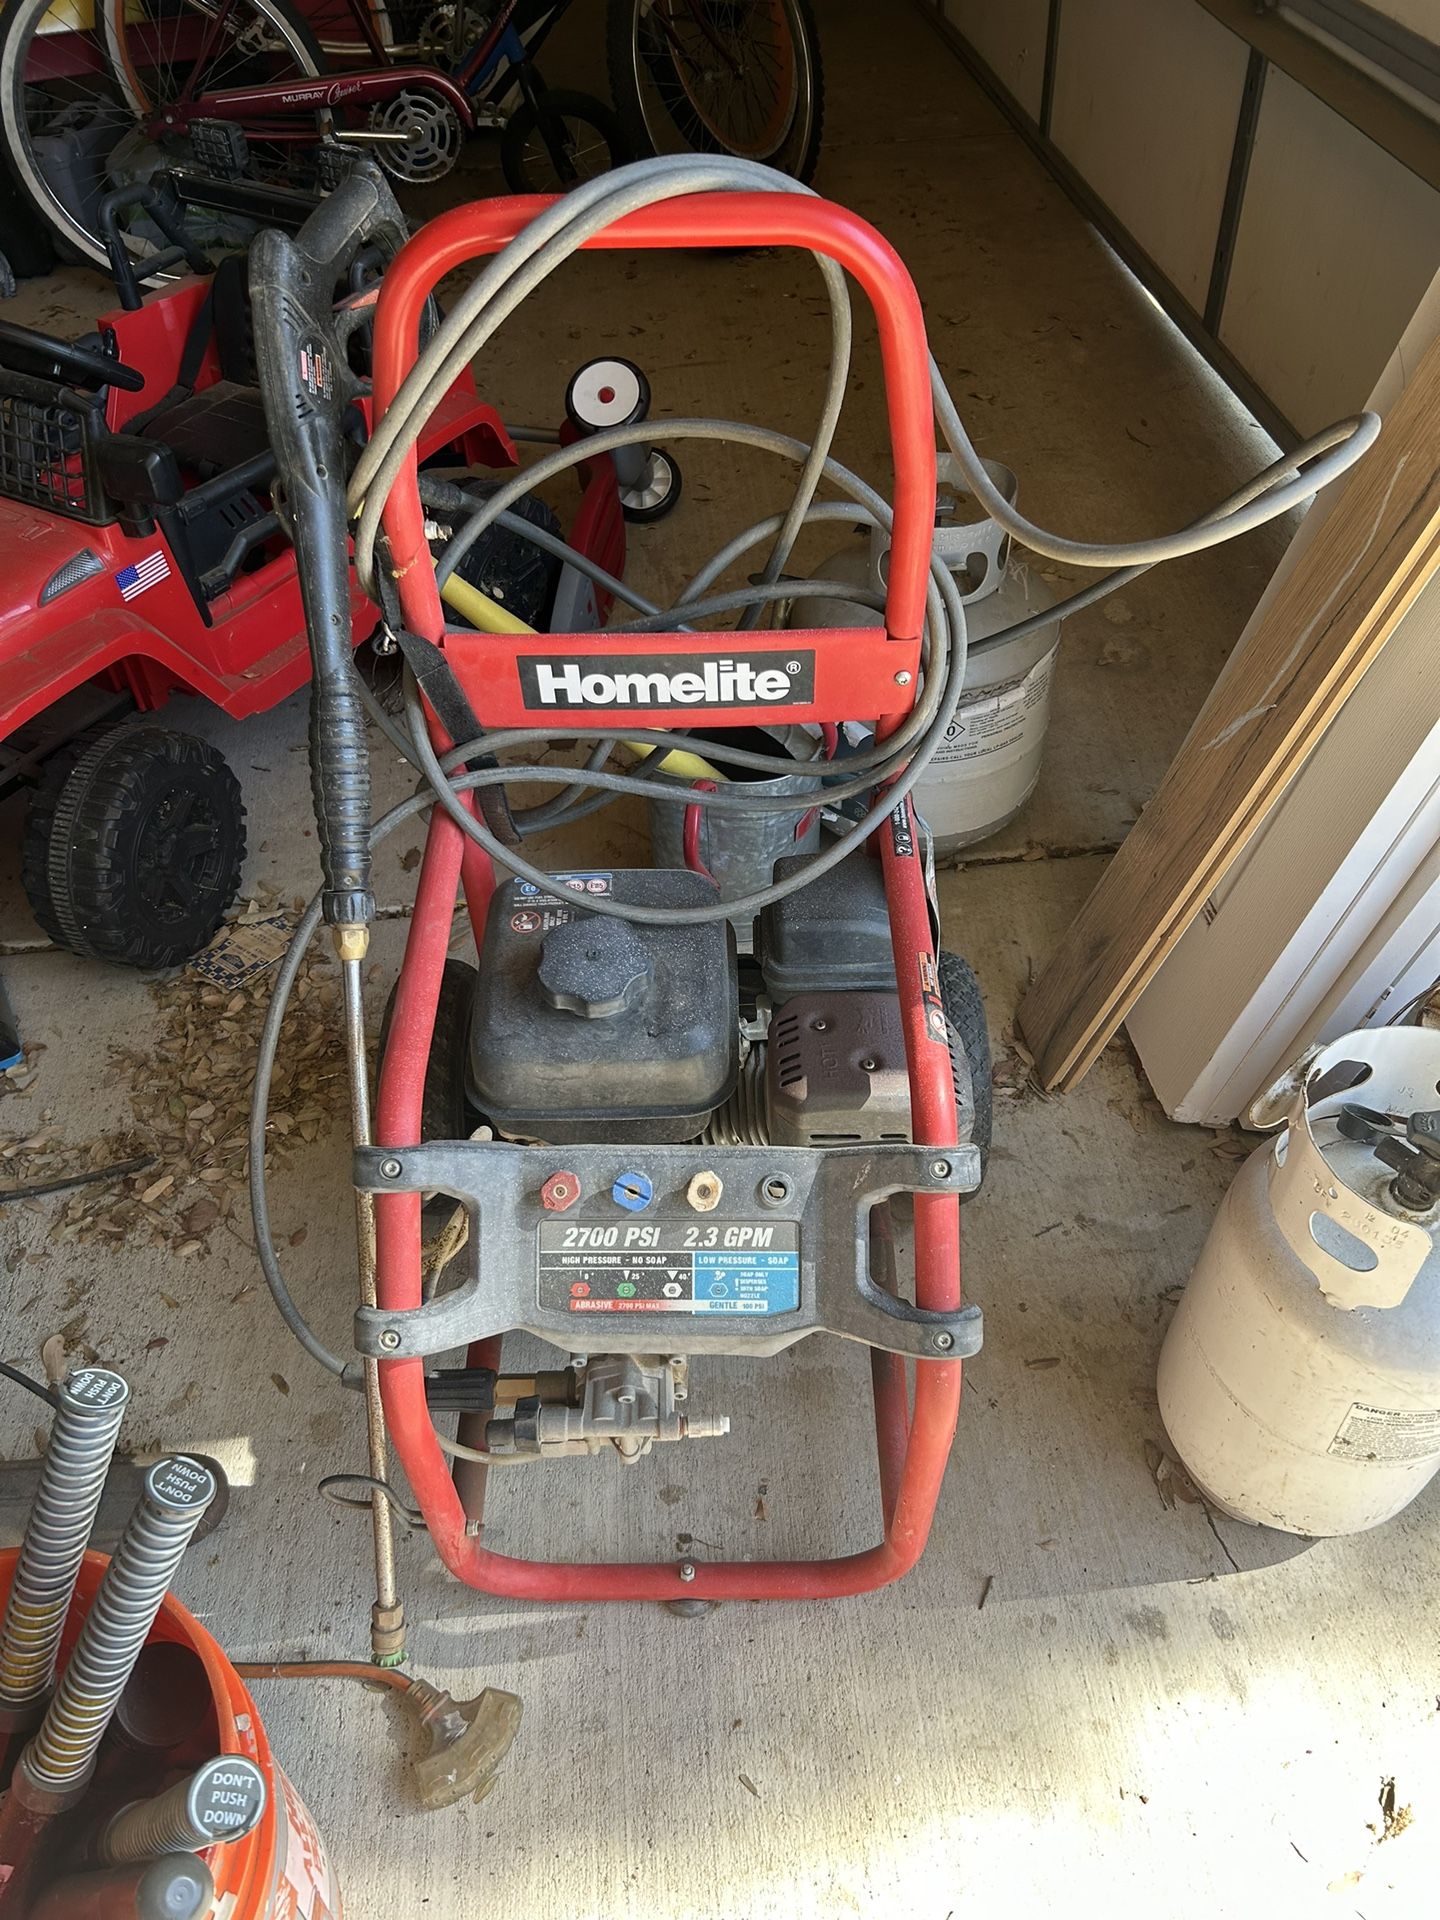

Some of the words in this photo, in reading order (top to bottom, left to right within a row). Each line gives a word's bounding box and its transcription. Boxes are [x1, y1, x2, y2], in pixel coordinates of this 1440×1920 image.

[282, 91, 325, 103] MURRAY
[327, 81, 362, 106] Cruiser
[562, 1227, 619, 1247] 2700
[624, 1227, 661, 1247] PSI
[683, 1227, 719, 1247] 2.3
[723, 1227, 774, 1247] GPM
[562, 1256, 580, 1264] HIGH
[583, 1256, 622, 1264] PRESSURE
[632, 1256, 643, 1264] NO
[646, 1256, 667, 1264] SOAP
[698, 1256, 716, 1264] LOW
[718, 1256, 757, 1265] PRESSURE
[767, 1256, 789, 1265] SOAP
[575, 1301, 614, 1309] ABRASIVE
[709, 1301, 738, 1309] GENTLE
[70, 1372, 96, 1395] DOWN
[84, 1379, 108, 1398] PUSH
[97, 1382, 121, 1404] DON'T
[1355, 1404, 1401, 1417] DANGER
[166, 1472, 198, 1493] PUSH
[171, 1463, 208, 1485] DOWN
[155, 1481, 193, 1503] DON'T
[212, 1772, 256, 1789] DON'T
[210, 1790, 248, 1807] PUSH
[203, 1810, 247, 1827] DOWN
